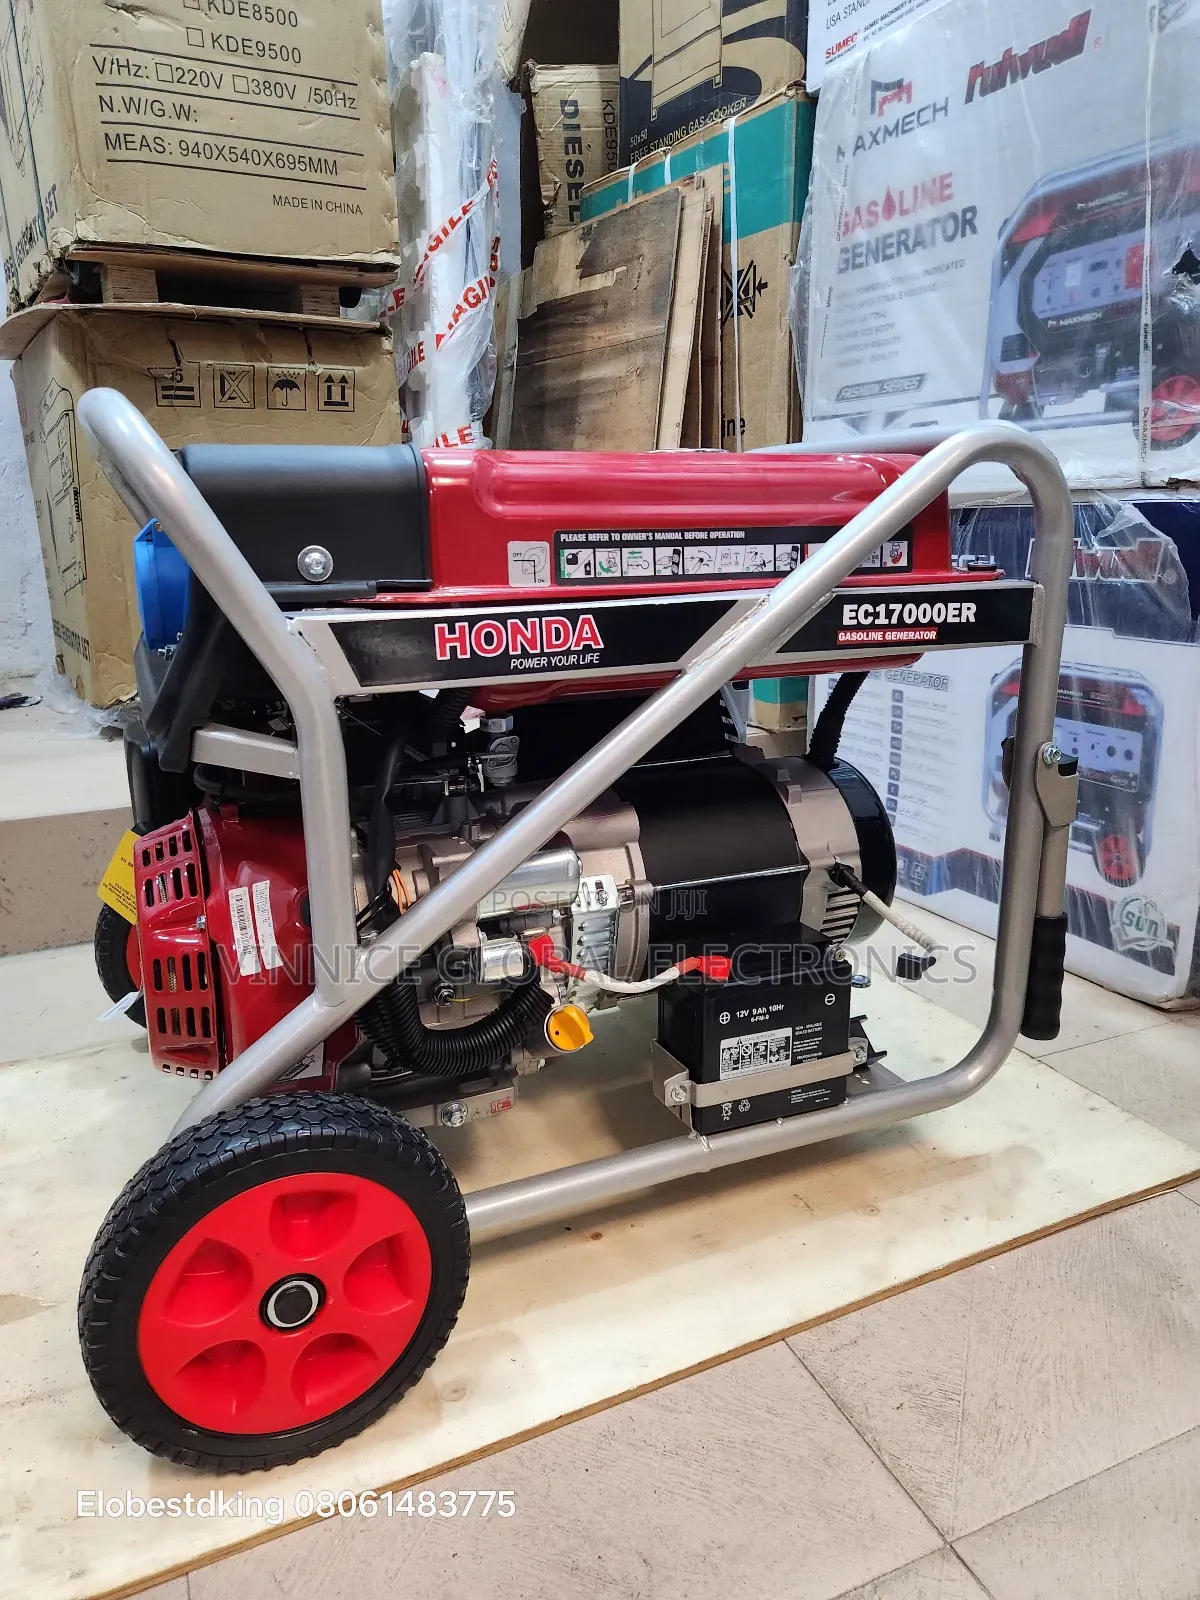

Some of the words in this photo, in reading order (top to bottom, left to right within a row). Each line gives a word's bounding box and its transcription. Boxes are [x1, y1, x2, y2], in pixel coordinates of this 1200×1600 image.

[207, 0, 298, 28] KDE8500
[826, 12, 842, 30] USA
[210, 32, 302, 64] KDE9500
[825, 31, 858, 59] SUMEC
[92, 56, 150, 80] V/Hz:
[175, 66, 224, 91] 220V
[251, 79, 297, 101] 380V
[308, 86, 358, 111] /50Hz
[98, 95, 199, 123] N.W/G.W:
[649, 126, 687, 154] STANDING
[688, 119, 705, 133] GAS
[706, 96, 748, 124] COOKER
[104, 132, 174, 156] MEAS:
[178, 139, 338, 177] 940X540X695MM
[559, 100, 588, 223] DIESEL
[272, 194, 305, 210] MADE
[306, 197, 322, 211] IN
[325, 198, 363, 216] CHINA
[837, 205, 978, 275] GENERATOR
[560, 533, 587, 542] PLEASE
[587, 533, 609, 542] REFER
[611, 533, 620, 541] TO
[621, 532, 653, 541] OWNER'S
[654, 531, 683, 541] MANUAL
[684, 530, 708, 540] BEFORE
[709, 529, 745, 539] OPERATION
[842, 602, 977, 626] EC17000ER
[434, 614, 604, 660] HONDA
[838, 631, 883, 641] GASOLINE
[885, 630, 937, 641] GENERATOR
[510, 657, 548, 670] POWER
[549, 655, 578, 667] YOUR
[579, 653, 600, 665] LIFE
[885, 670, 950, 692] GENERATOR
[735, 1009, 750, 1019] 12V
[752, 1007, 767, 1016] 9Ah
[768, 1004, 785, 1013] 10Hr
